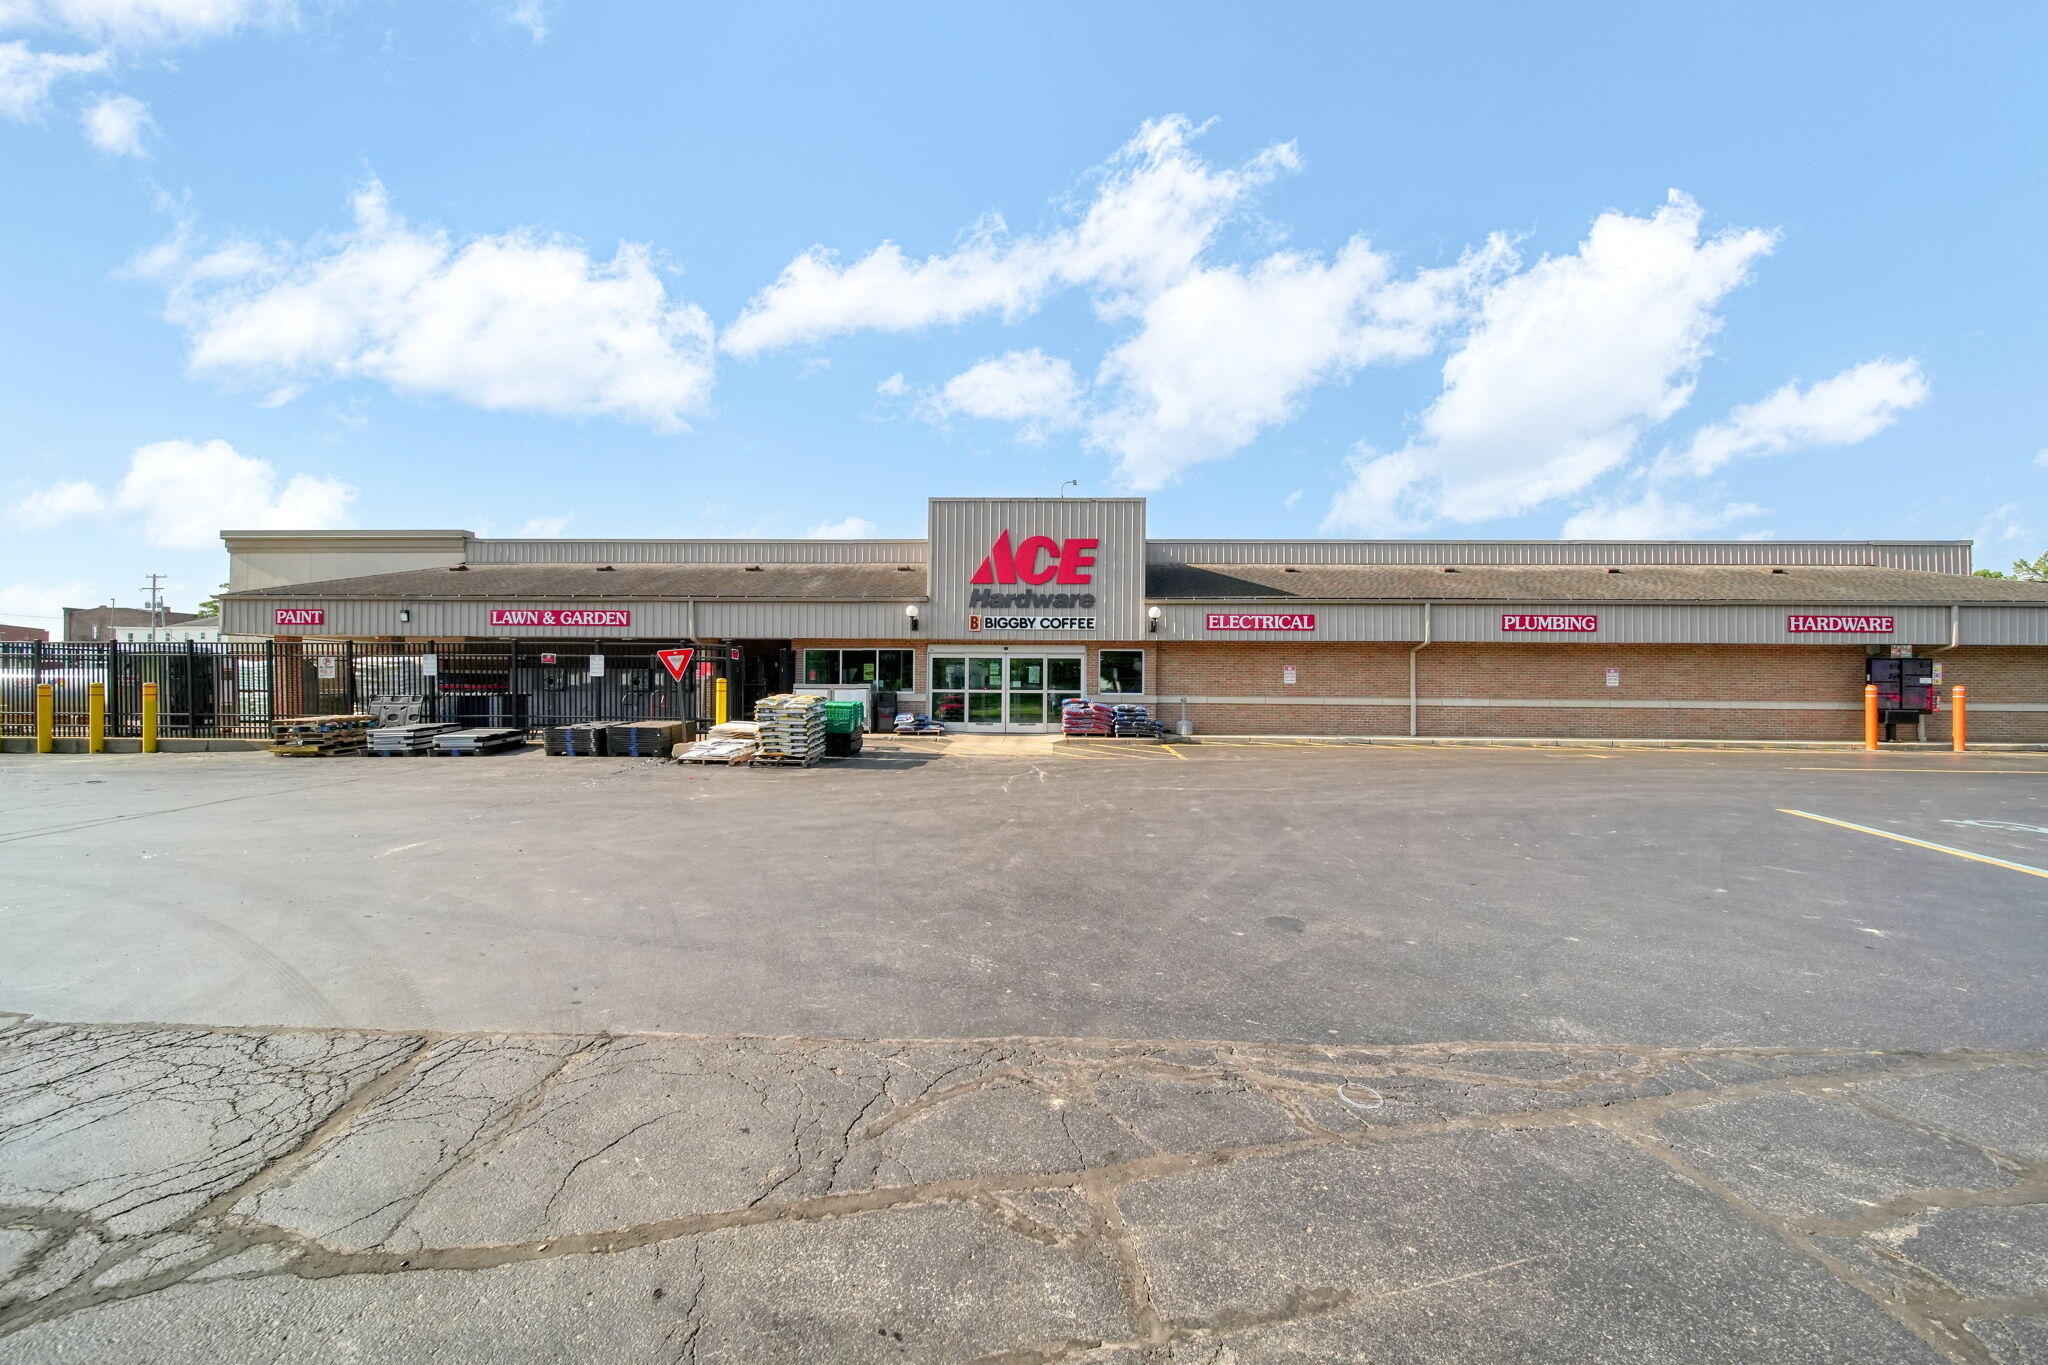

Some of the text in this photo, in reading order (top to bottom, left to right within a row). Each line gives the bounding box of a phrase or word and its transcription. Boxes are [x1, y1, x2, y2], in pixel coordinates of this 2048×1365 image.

[969, 528, 1099, 585] ACE
[968, 588, 1096, 609] Hardware
[276, 610, 323, 624] PAINT
[491, 611, 628, 626] LAWN & GARDEN
[970, 616, 979, 629] B
[985, 617, 1095, 629] BIGGBY COFFEE
[1208, 615, 1314, 630] ELECTRICAL
[1503, 616, 1596, 631] PLUMBING
[1789, 616, 1893, 632] HARDWARE
